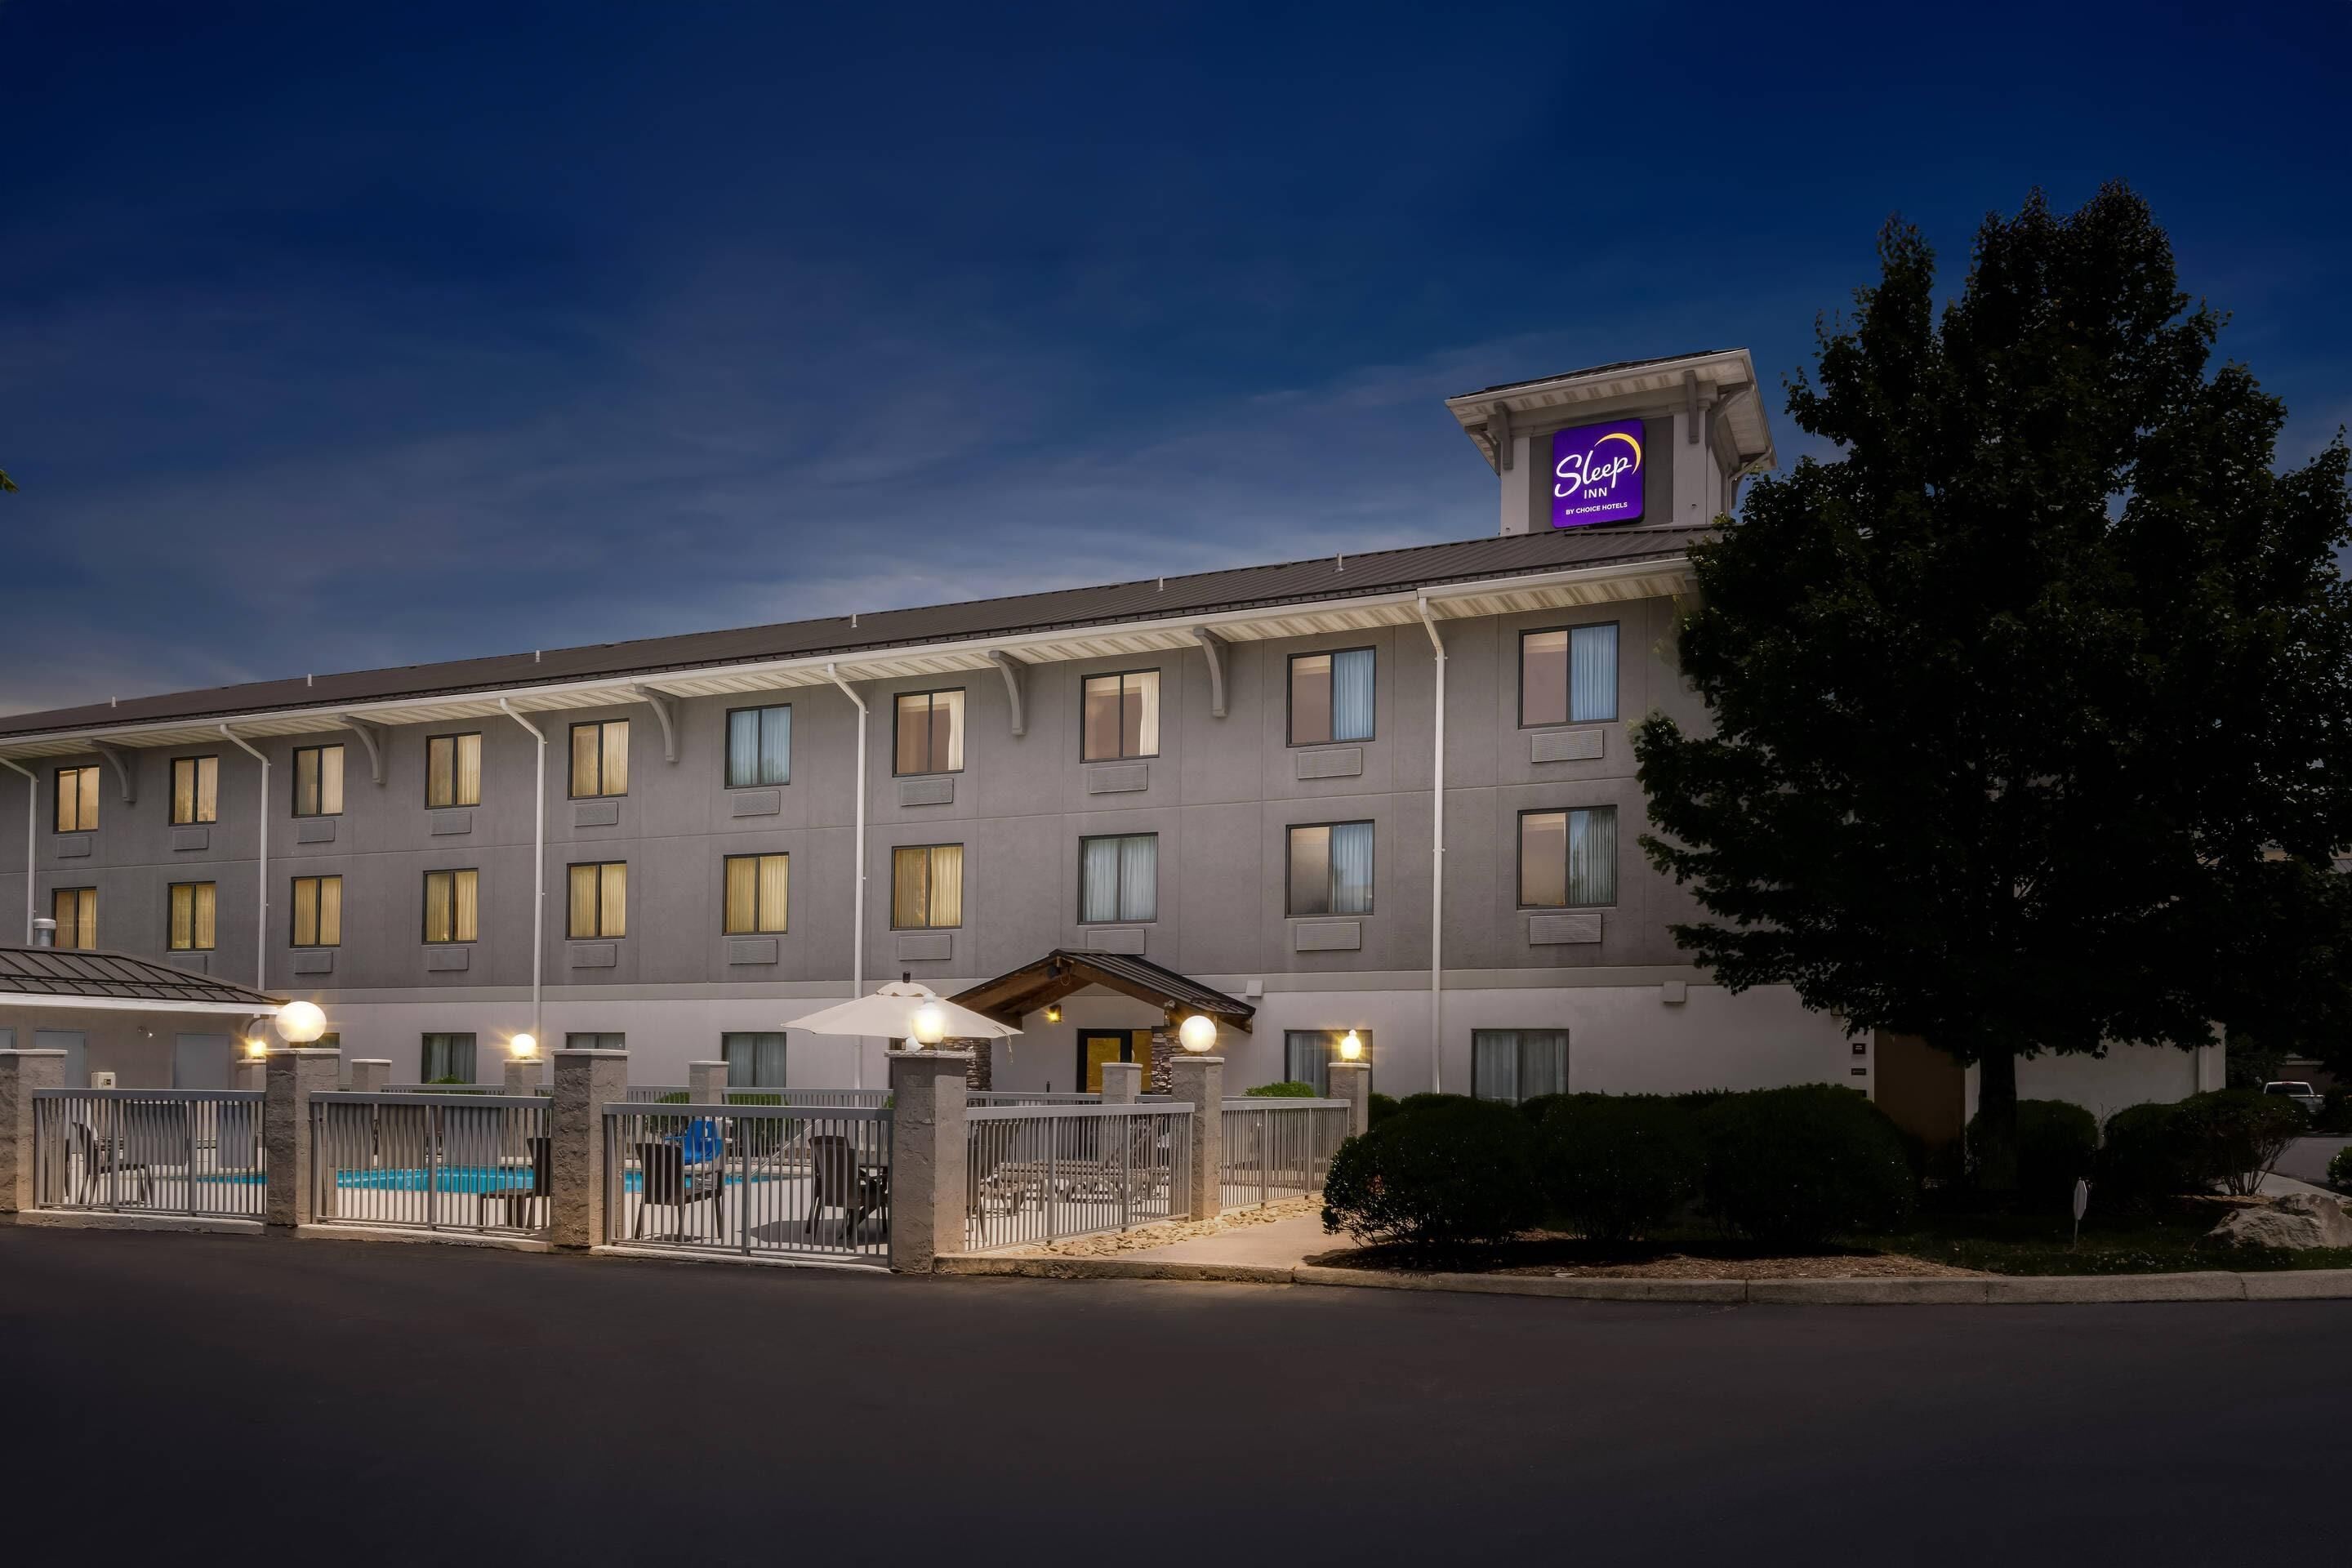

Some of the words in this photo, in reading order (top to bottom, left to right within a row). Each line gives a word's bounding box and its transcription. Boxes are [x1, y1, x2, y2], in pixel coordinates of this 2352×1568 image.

[1554, 450, 1633, 497] Sleep
[1584, 487, 1607, 499] INN
[1575, 506, 1601, 514] CHOICE
[1601, 501, 1628, 510] HOTELS
